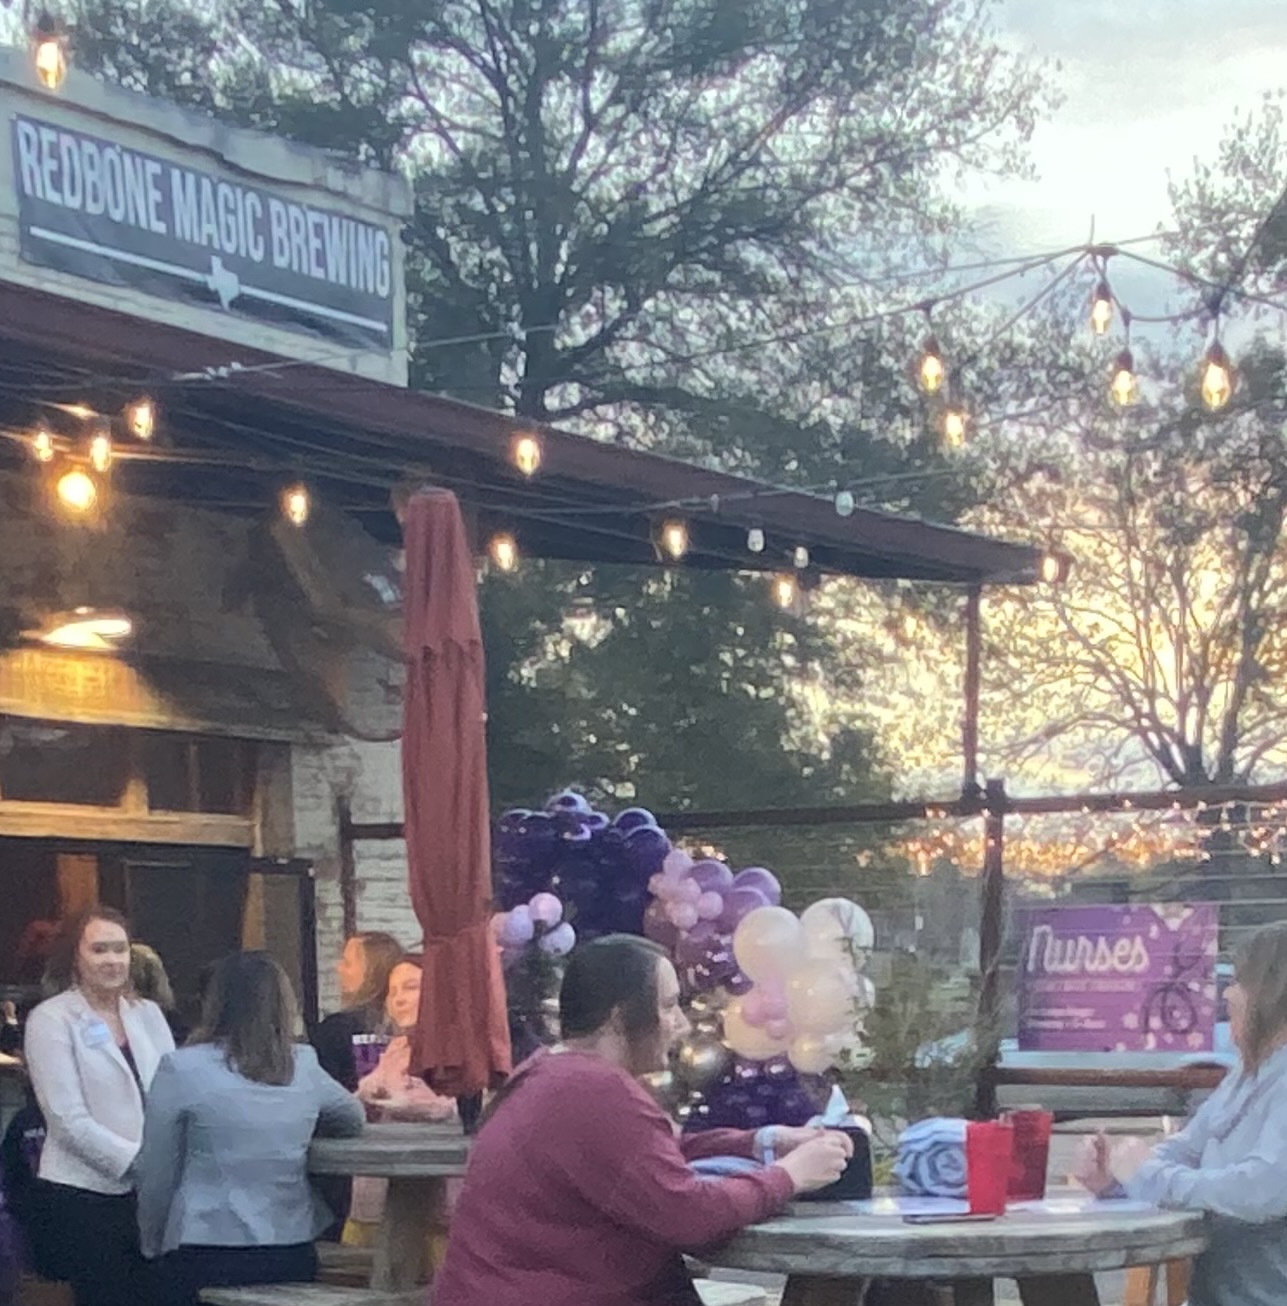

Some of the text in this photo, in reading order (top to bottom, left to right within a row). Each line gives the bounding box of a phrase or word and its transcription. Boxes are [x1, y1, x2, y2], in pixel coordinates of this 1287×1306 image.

[17, 120, 391, 299] REDBONE MAGIC BREWING
[1027, 925, 1149, 972] Nurses
